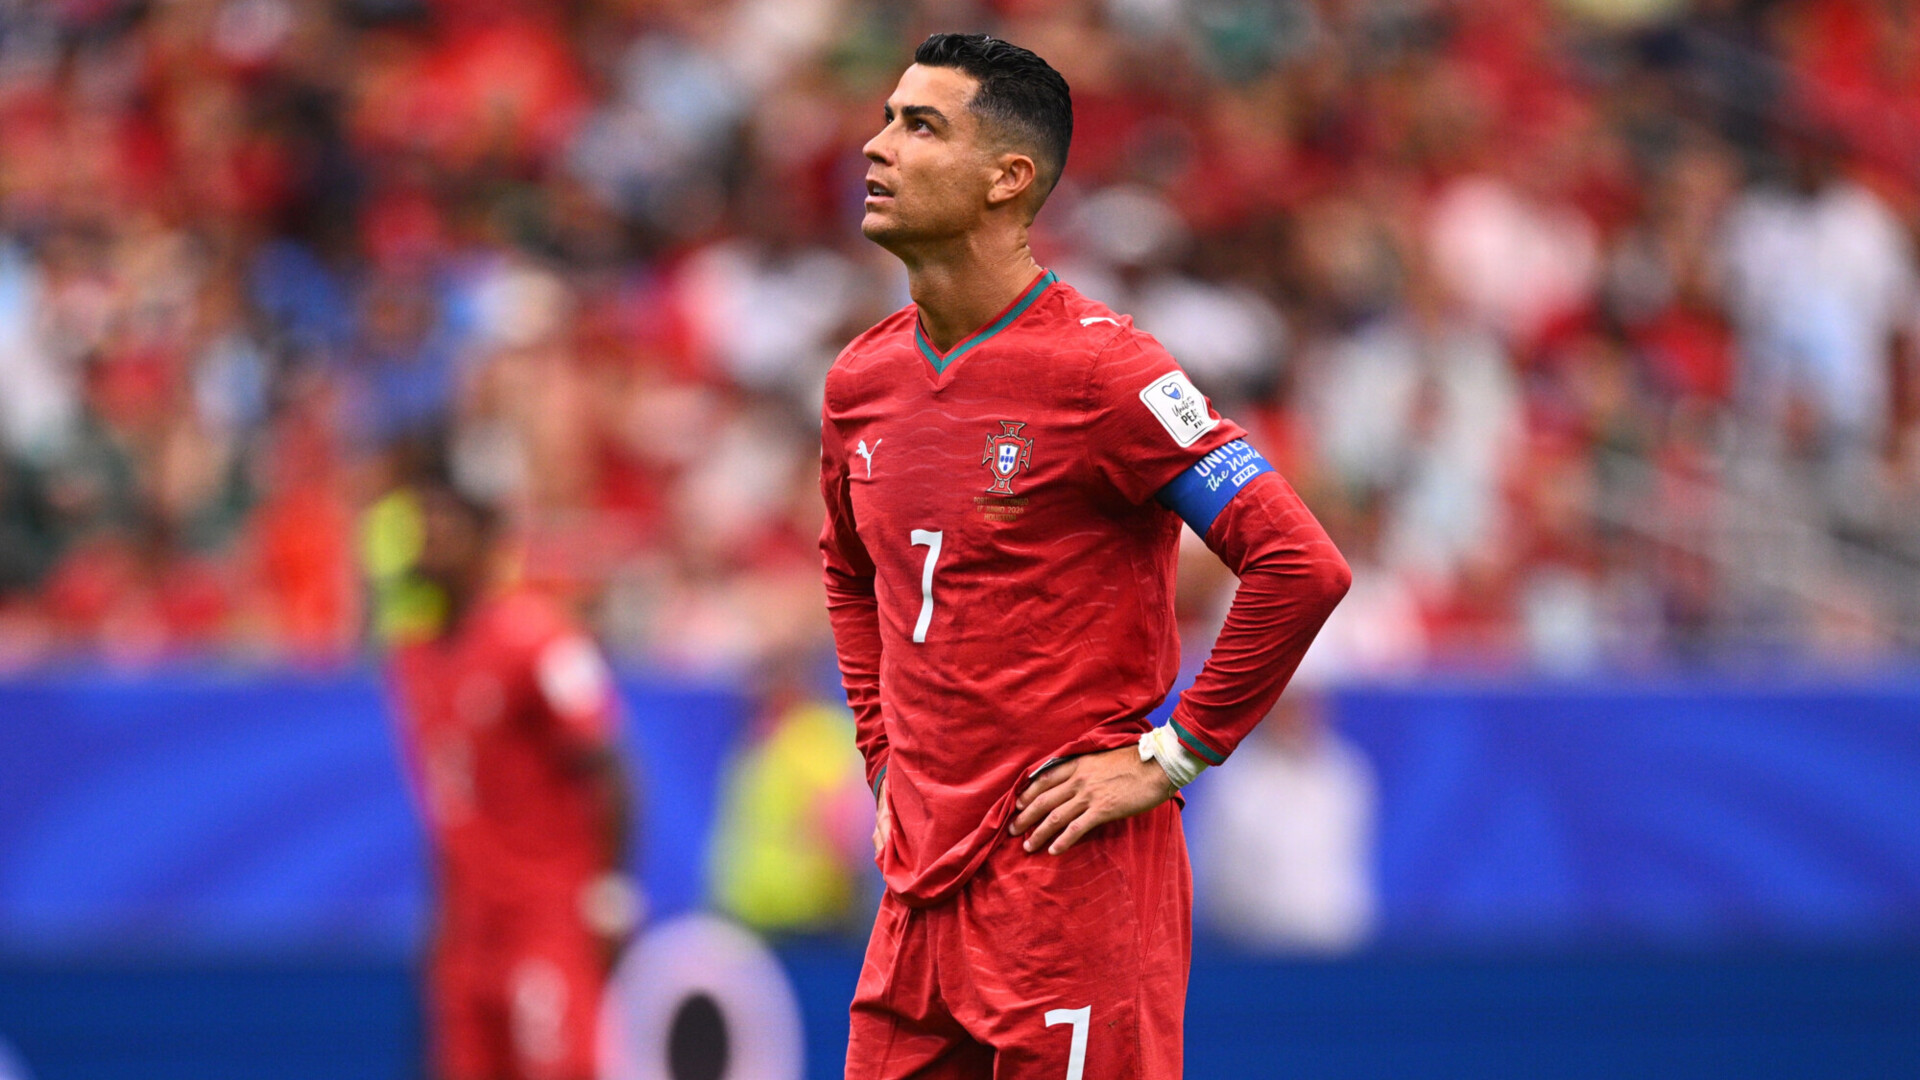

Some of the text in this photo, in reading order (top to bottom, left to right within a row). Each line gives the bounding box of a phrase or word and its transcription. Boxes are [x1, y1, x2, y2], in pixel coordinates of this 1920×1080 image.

[1181, 408, 1201, 426] PEA
[1206, 473, 1229, 492] the
[1232, 464, 1258, 486] FIFA
[910, 528, 943, 643] 7
[1044, 1004, 1092, 1080] 7
